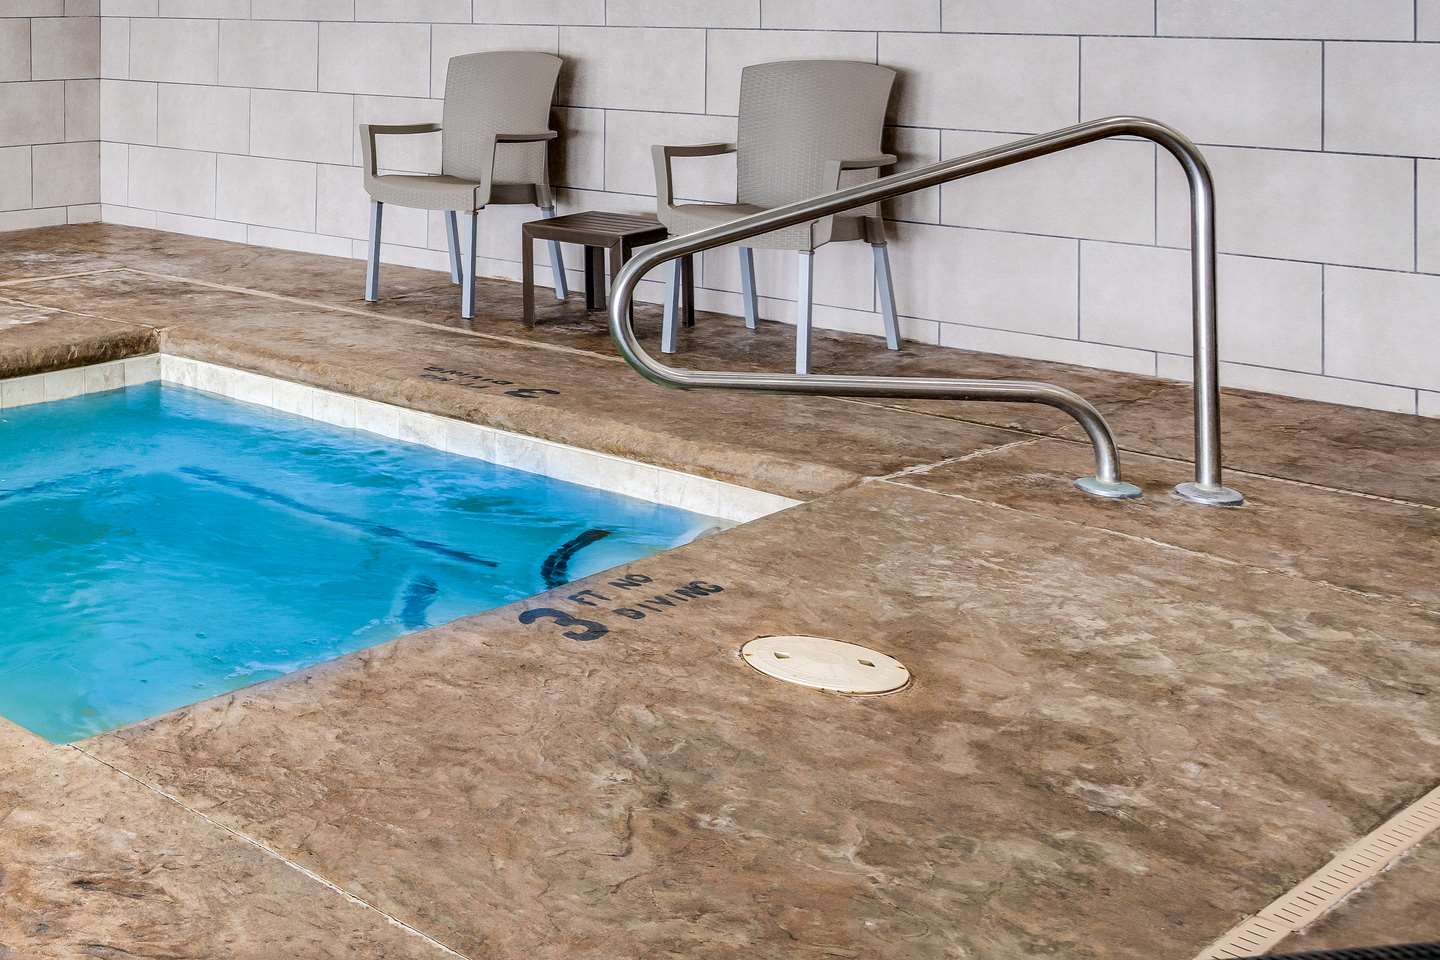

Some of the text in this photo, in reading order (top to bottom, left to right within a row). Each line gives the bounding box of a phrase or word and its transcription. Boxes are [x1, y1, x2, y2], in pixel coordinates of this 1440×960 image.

[518, 573, 653, 641] 3 FT NO
[612, 580, 725, 620] DIVING
